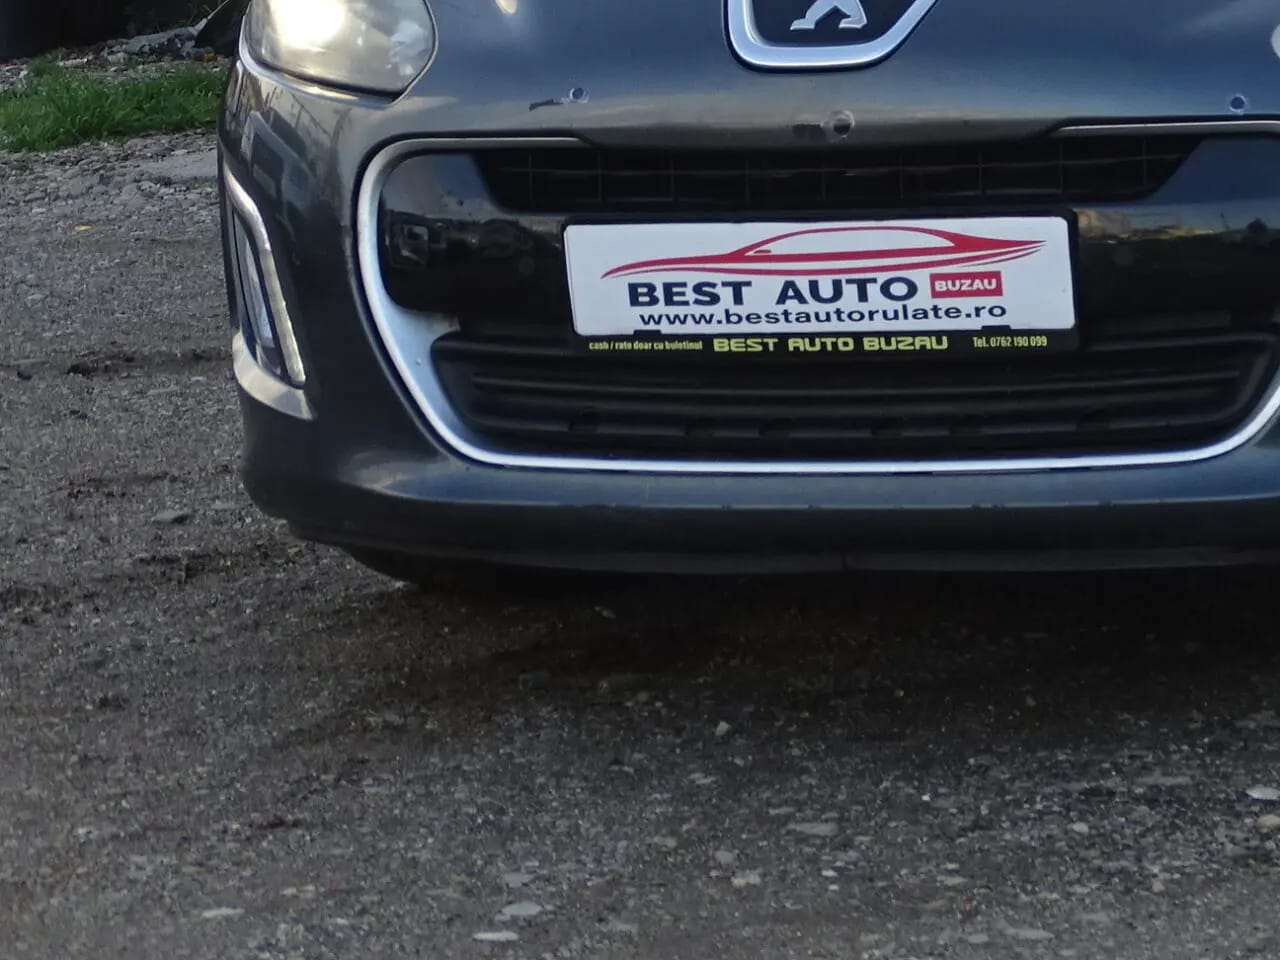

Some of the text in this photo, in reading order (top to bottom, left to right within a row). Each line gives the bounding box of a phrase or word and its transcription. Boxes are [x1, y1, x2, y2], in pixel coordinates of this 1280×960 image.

[627, 276, 918, 307] BEST AUTO
[934, 278, 997, 292] BUZAU
[638, 304, 1007, 327] www.bestautorulate.ro
[713, 337, 779, 352] BEST
[787, 337, 854, 352] AUTO
[862, 335, 949, 351] BUZAU
[990, 336, 1012, 347] 0762
[1013, 335, 1029, 347] 190
